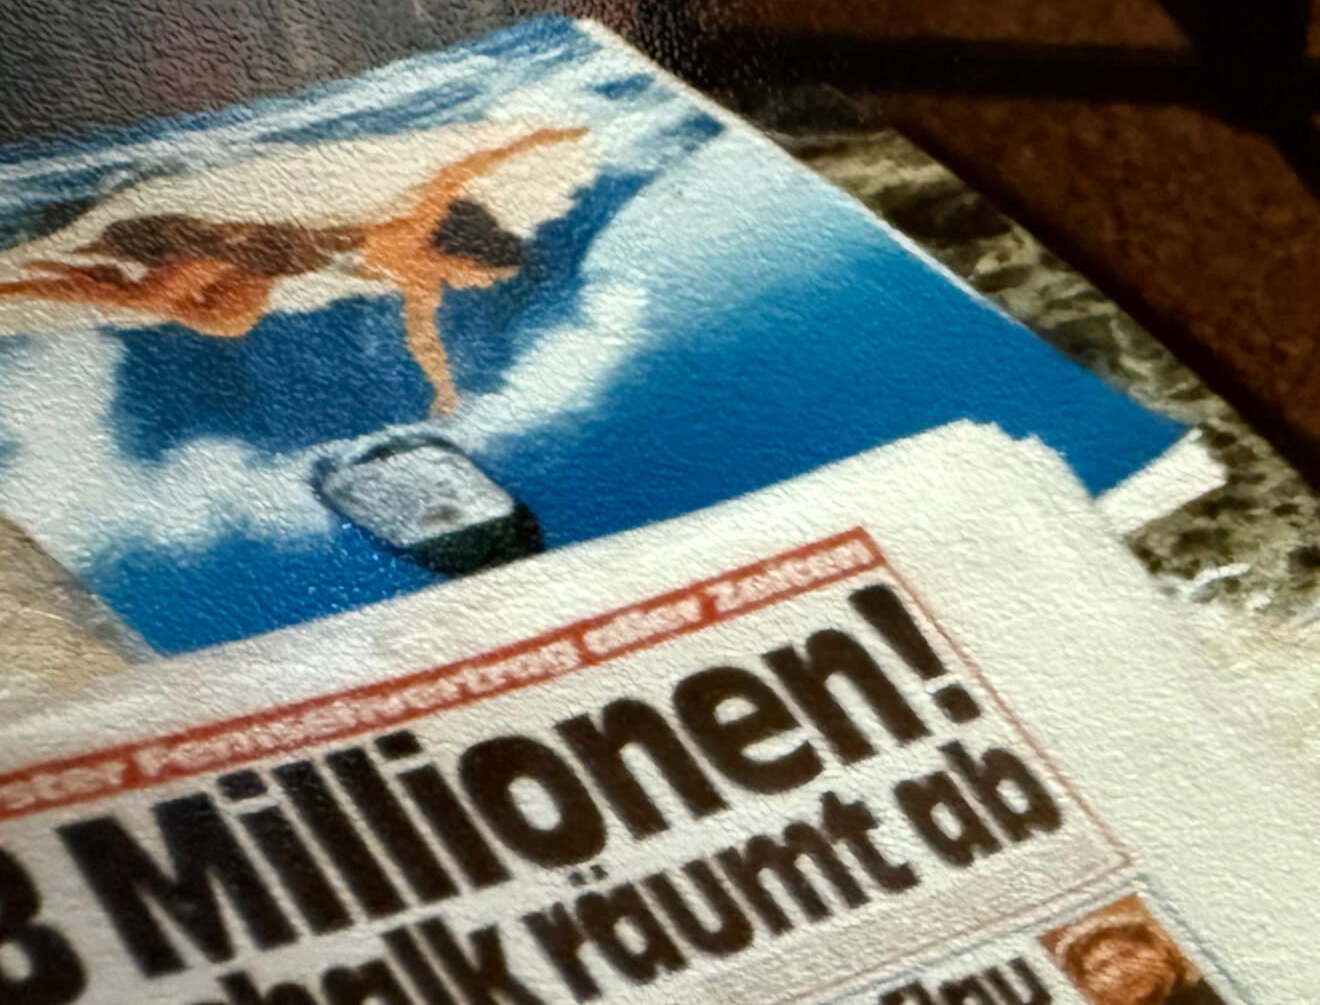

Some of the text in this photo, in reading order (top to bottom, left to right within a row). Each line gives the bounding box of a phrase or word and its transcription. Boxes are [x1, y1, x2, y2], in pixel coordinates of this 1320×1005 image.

[582, 596, 701, 655] aller
[705, 539, 876, 614] Zeiten
[54, 584, 981, 979] Millionen!
[521, 791, 922, 1001] räumt
[893, 740, 1063, 867] ab
